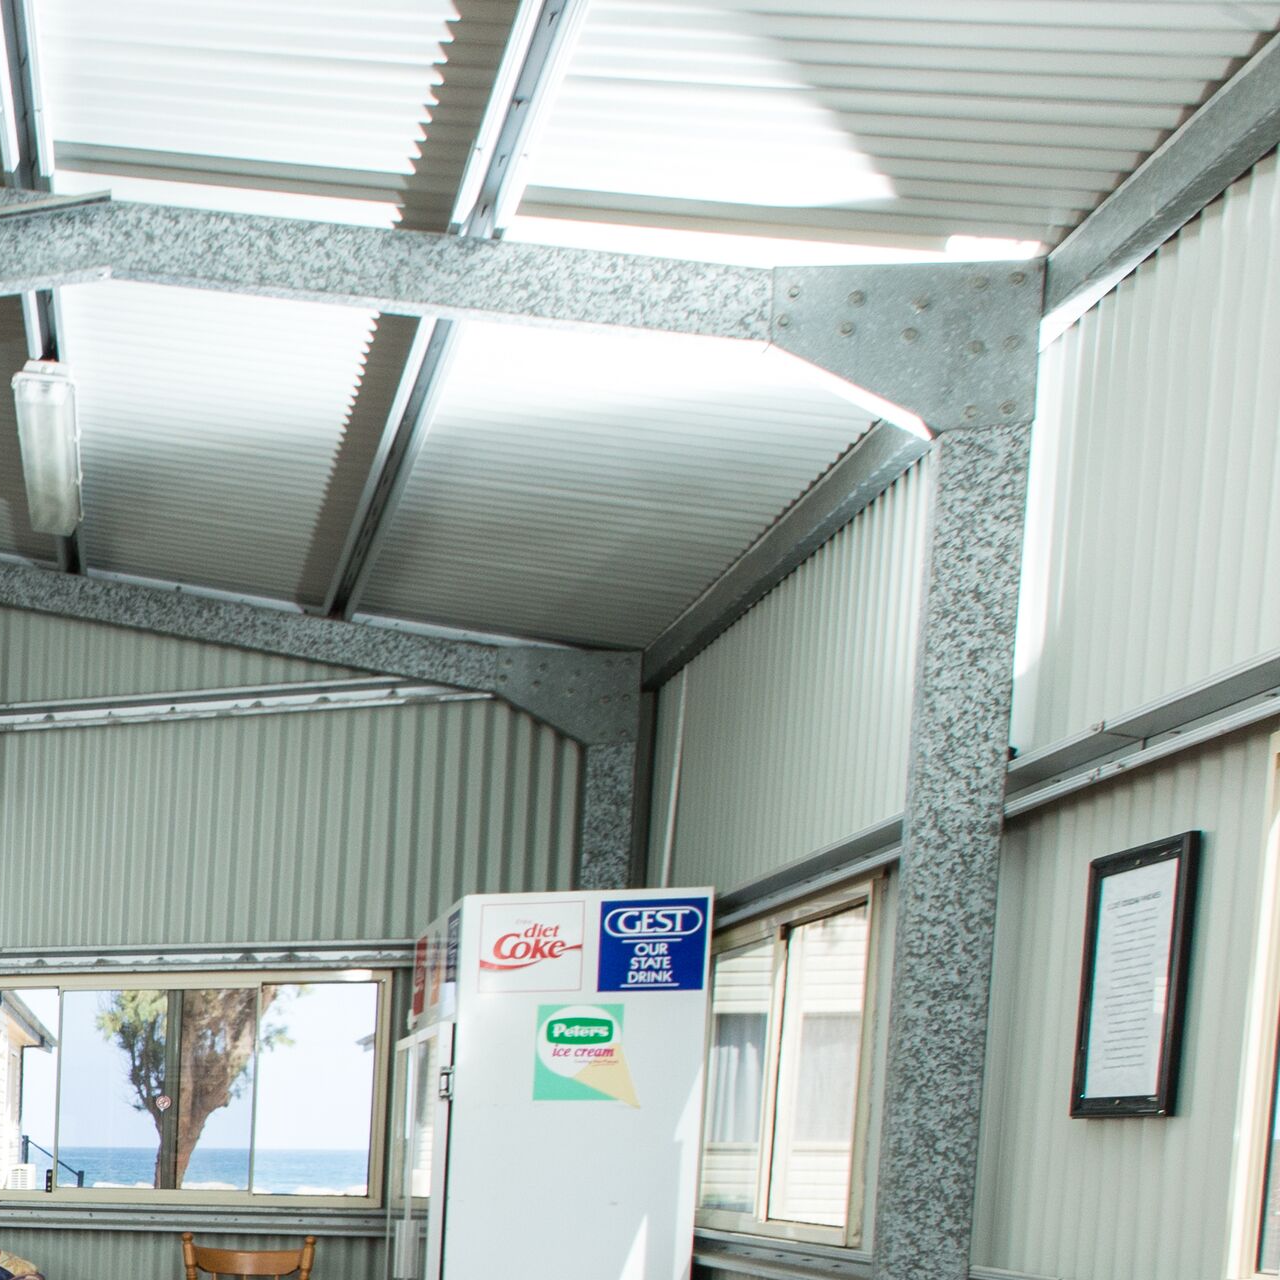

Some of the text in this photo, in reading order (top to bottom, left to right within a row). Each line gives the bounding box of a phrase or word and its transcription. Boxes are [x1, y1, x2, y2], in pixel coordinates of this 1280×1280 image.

[617, 909, 690, 934] GEST
[524, 923, 560, 938] diet
[493, 933, 566, 959] Coke
[634, 943, 668, 955] OUR
[630, 957, 671, 969] STATE
[628, 970, 673, 983] DRINK
[552, 1023, 609, 1037] Peters
[552, 1043, 614, 1057] ice cream
